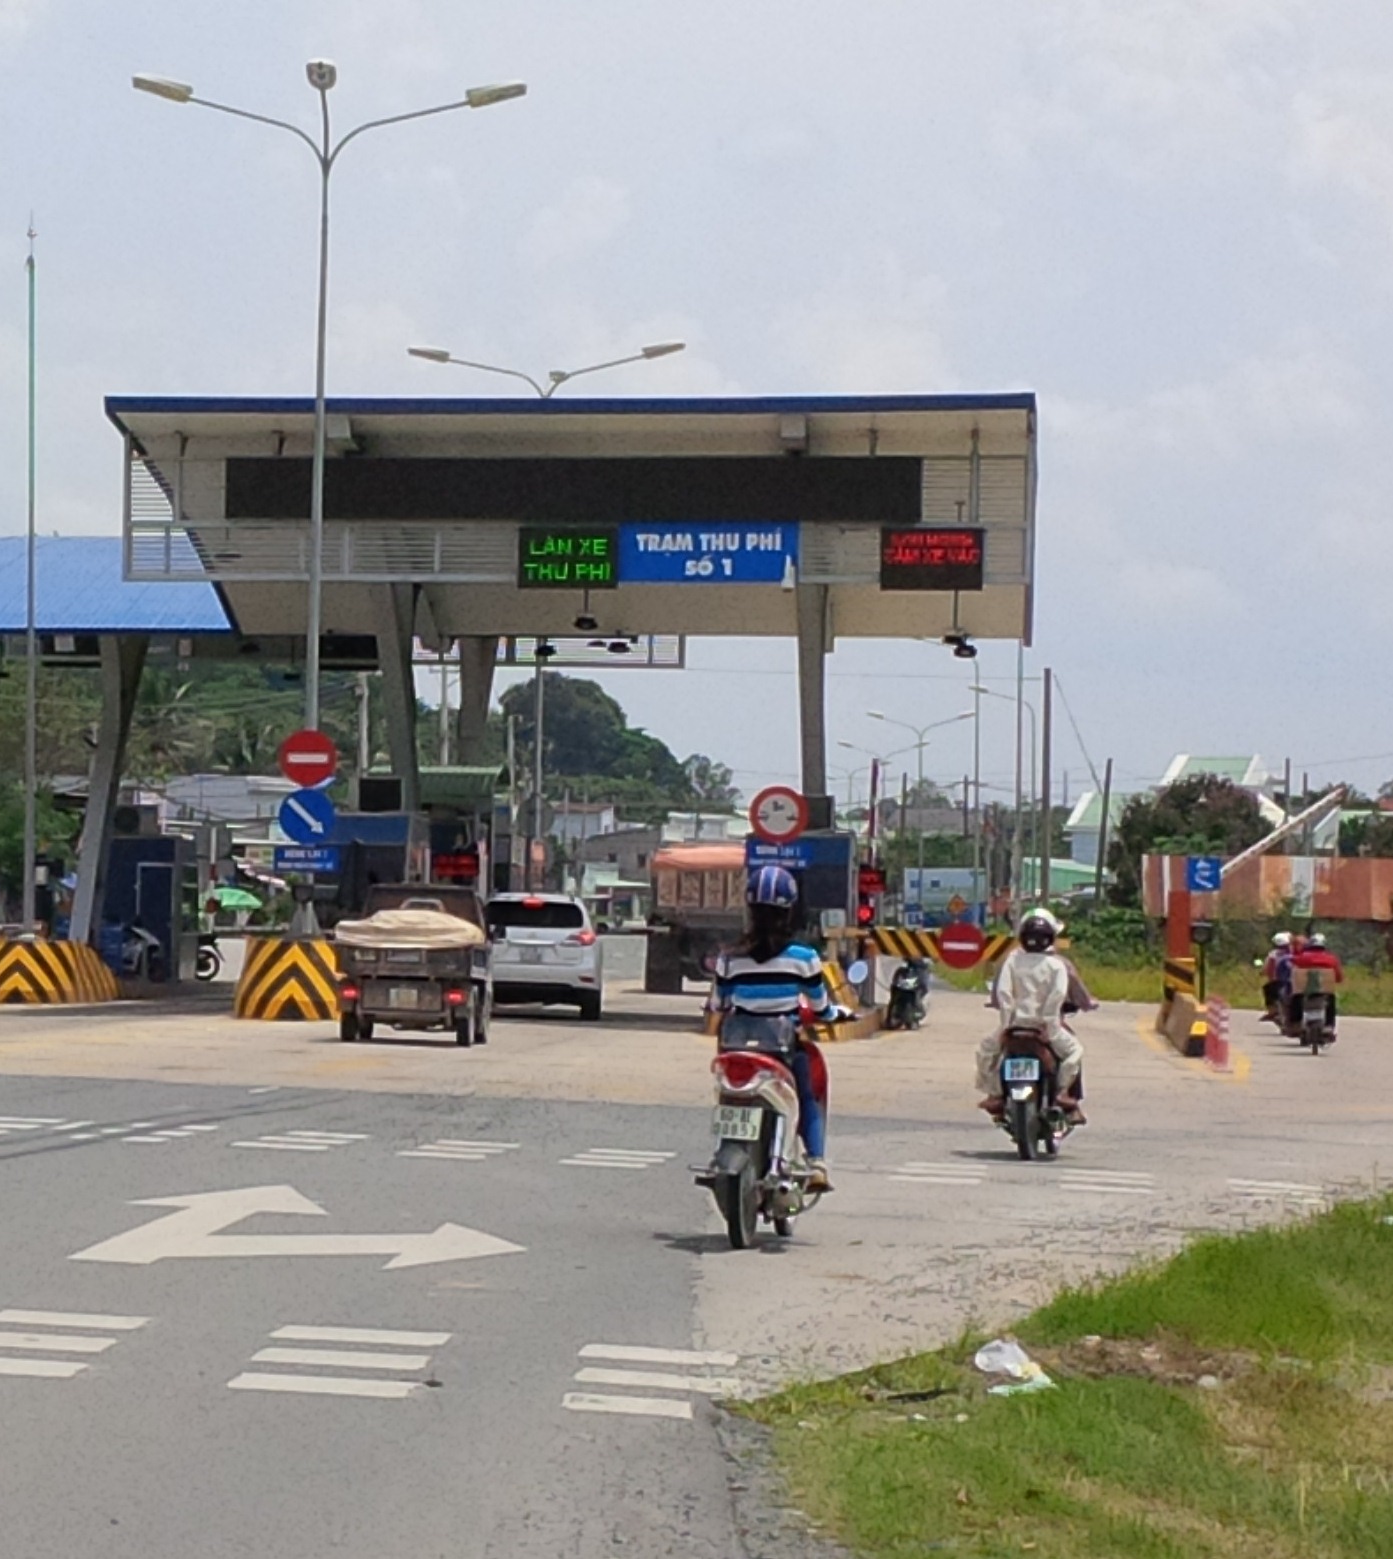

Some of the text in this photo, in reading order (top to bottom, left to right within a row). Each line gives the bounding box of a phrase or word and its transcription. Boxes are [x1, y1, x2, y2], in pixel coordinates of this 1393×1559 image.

[579, 538, 608, 555] XE
[699, 532, 740, 552] THU
[746, 527, 783, 552] PHÍ
[523, 562, 569, 580] THU
[720, 557, 733, 577] 1
